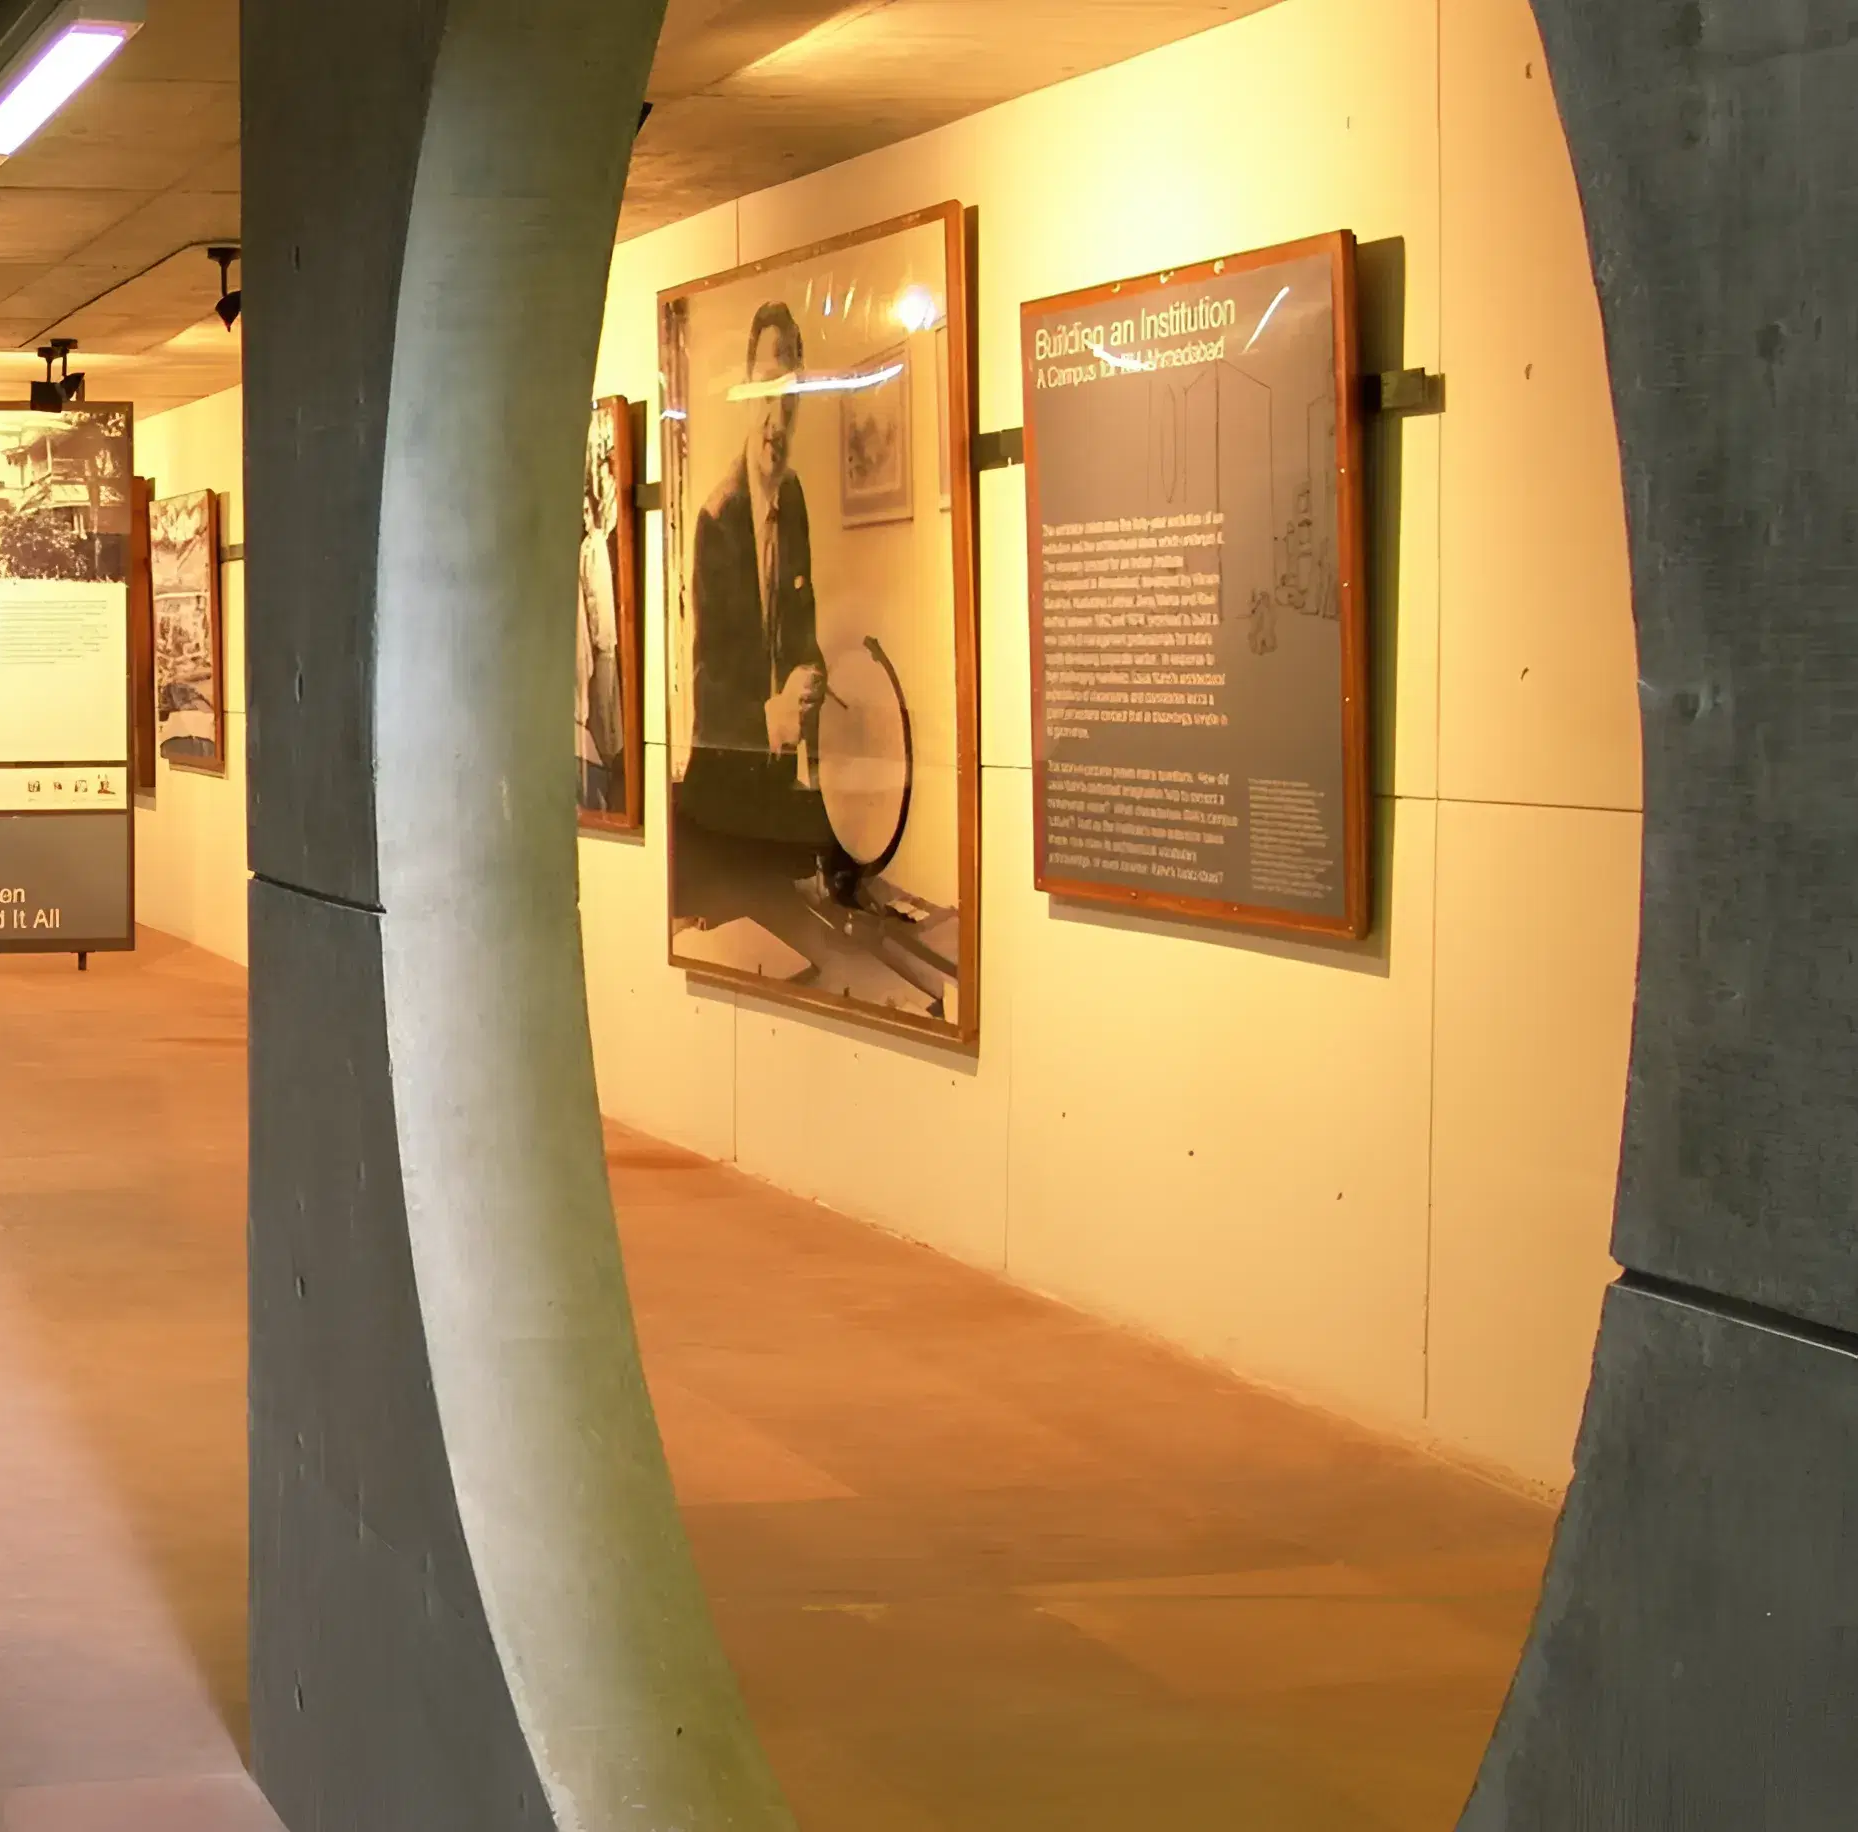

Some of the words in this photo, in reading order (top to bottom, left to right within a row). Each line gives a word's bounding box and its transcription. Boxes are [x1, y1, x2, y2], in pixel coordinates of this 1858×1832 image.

[1035, 322, 1104, 361] Building
[1110, 319, 1135, 346] an
[1141, 296, 1236, 341] Institution
[1036, 368, 1046, 389] A
[1047, 363, 1097, 388] Campus
[13, 908, 27, 929] It
[33, 908, 61, 929] All
